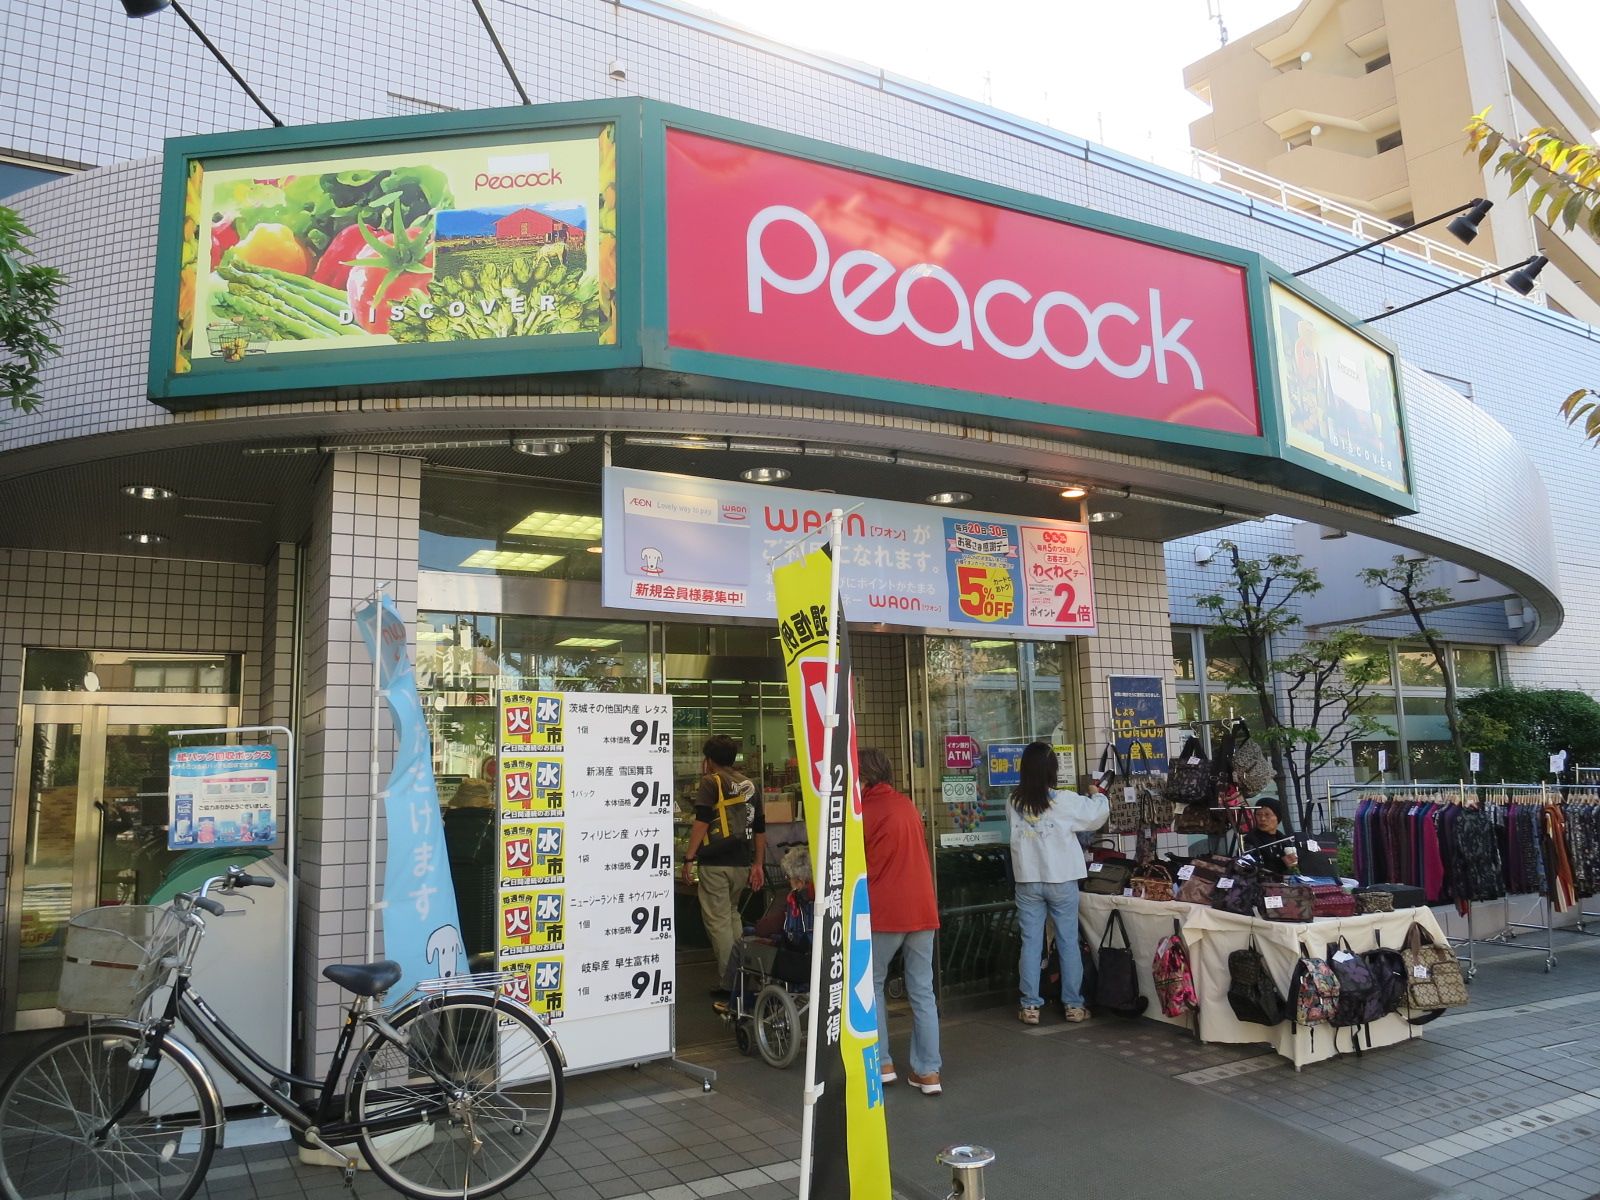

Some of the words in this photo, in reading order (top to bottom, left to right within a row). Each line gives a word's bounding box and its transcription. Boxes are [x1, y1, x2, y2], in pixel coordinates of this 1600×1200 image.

[475, 168, 562, 191] Peacock
[746, 204, 1205, 391] Peacock
[338, 294, 558, 326] DISCOVER
[1033, 563, 1084, 581] わくわくデー
[634, 582, 743, 604] 新規会員様募集中!
[868, 593, 921, 611] WAON
[983, 601, 1013, 618] OFF
[1030, 606, 1055, 617] ポイント
[537, 699, 559, 721] 水
[645, 705, 668, 714] レタス
[507, 709, 530, 732] 火
[546, 726, 562, 744] 市
[603, 736, 631, 744] 本体価格
[948, 750, 971, 761] ATM
[537, 763, 559, 786] 水
[618, 765, 653, 776] 雪国舞茸
[507, 774, 530, 798] 火
[546, 791, 563, 809] 市
[604, 798, 631, 807] 本体価格
[537, 829, 560, 852] 水
[634, 827, 660, 837] バナナ
[507, 841, 530, 866] 火
[546, 857, 563, 875] 市
[604, 862, 631, 871] 本体価格
[537, 895, 560, 919] 水
[826, 763, 843, 1046] 2日間連続のお買得
[505, 909, 529, 934] 火
[546, 924, 563, 943] 市
[604, 926, 632, 936] 本体価格
[536, 963, 559, 988] 水
[545, 992, 563, 1011] 市
[604, 991, 632, 1002] 本体価格
